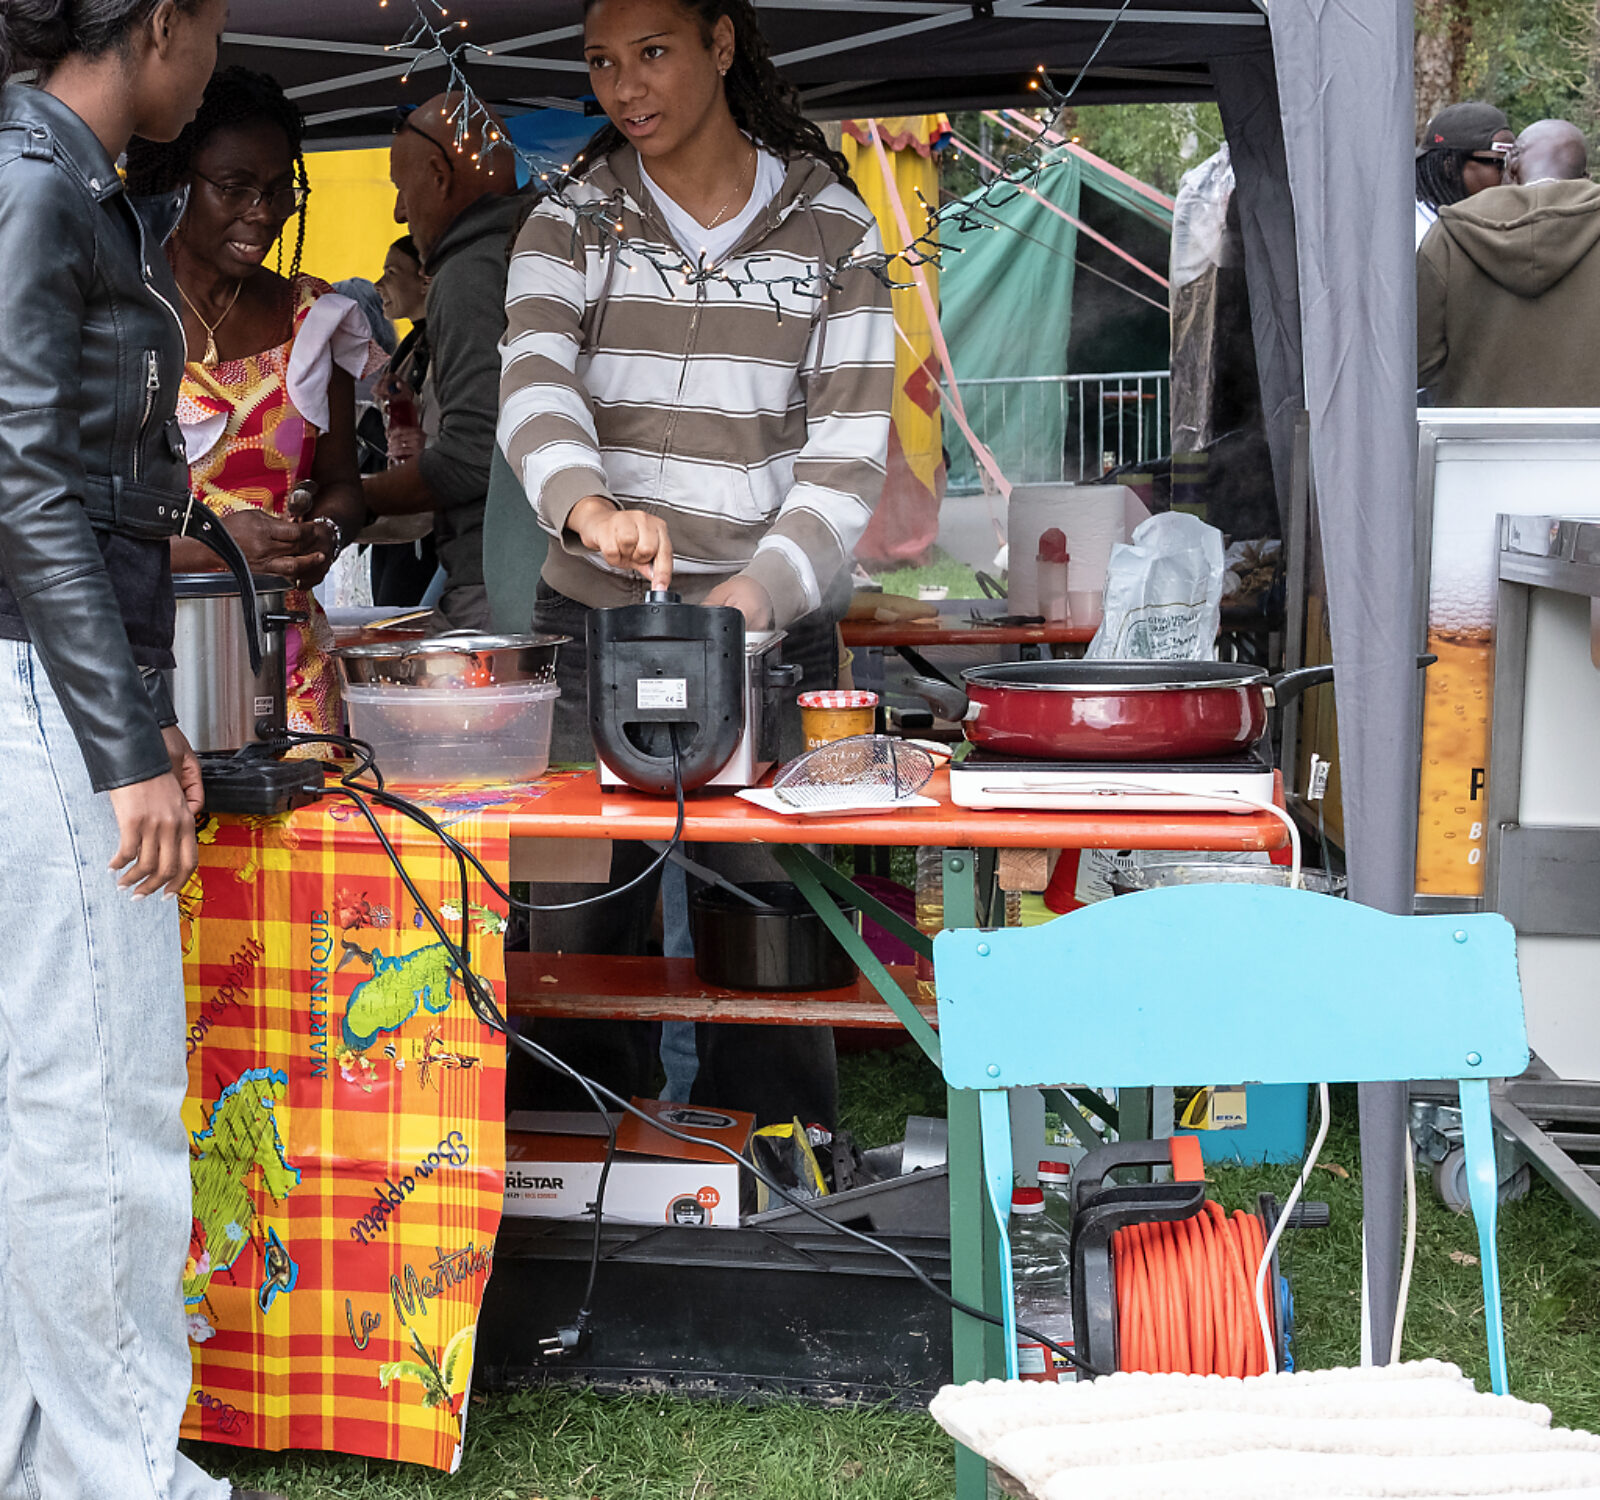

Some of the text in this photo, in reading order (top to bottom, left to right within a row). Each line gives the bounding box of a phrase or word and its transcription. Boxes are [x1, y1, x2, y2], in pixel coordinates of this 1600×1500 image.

[211, 937, 266, 1014] appétit
[309, 910, 334, 1080] MARTINIQUE
[350, 1131, 470, 1246] Bon appétit
[699, 1192, 718, 1203] 2.2L
[345, 1298, 381, 1350] La
[193, 1389, 249, 1436] Bon
